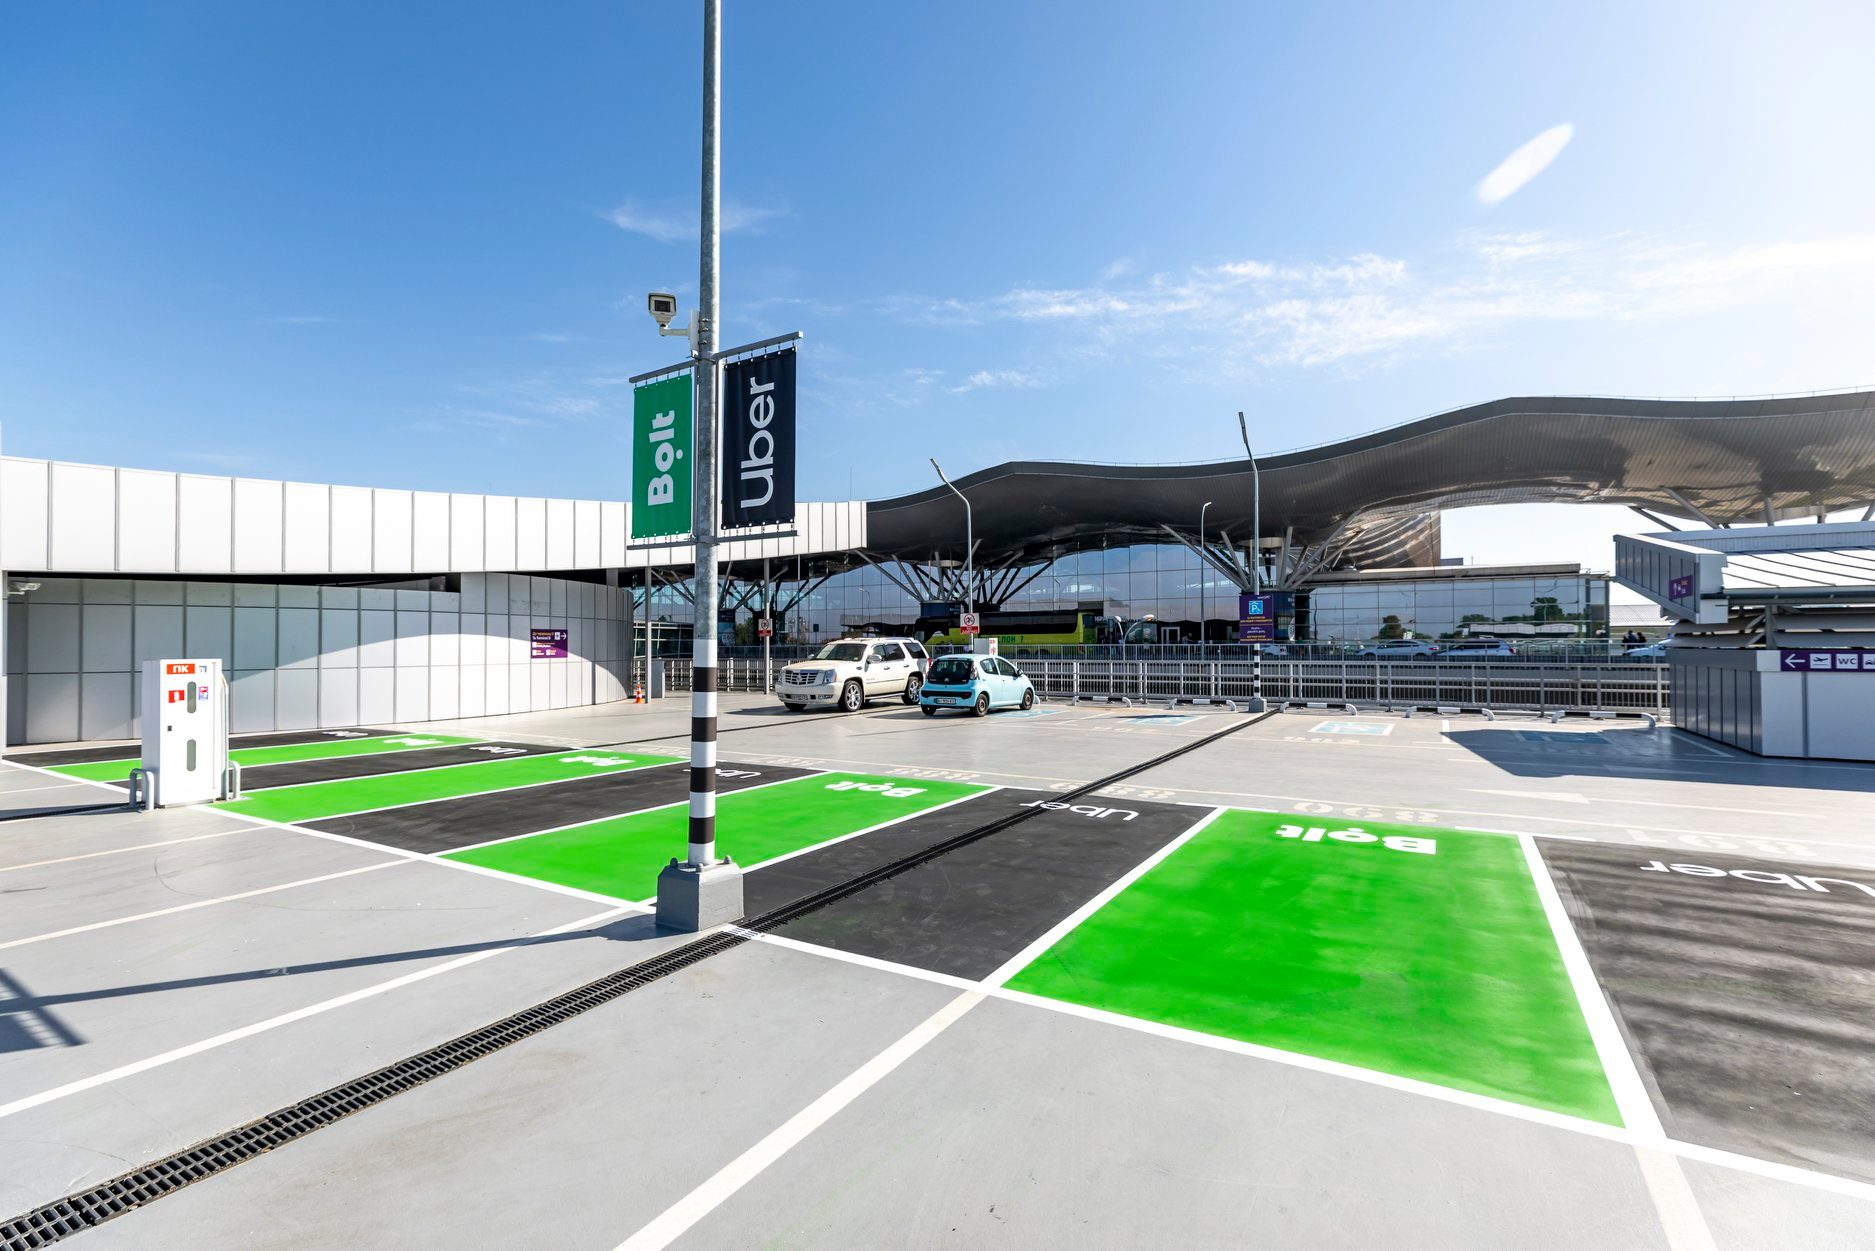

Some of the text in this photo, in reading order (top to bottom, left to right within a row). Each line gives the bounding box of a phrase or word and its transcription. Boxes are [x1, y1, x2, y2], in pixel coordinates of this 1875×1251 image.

[740, 376, 775, 509] Uber
[647, 408, 684, 507] Bolt
[172, 664, 189, 673] ПК
[1838, 657, 1857, 665] WC
[824, 781, 928, 798] Bolt
[1018, 799, 1140, 822] Uber
[1293, 801, 1440, 823] 890
[1275, 824, 1437, 856] Bolt
[1640, 859, 1875, 899] Uber
